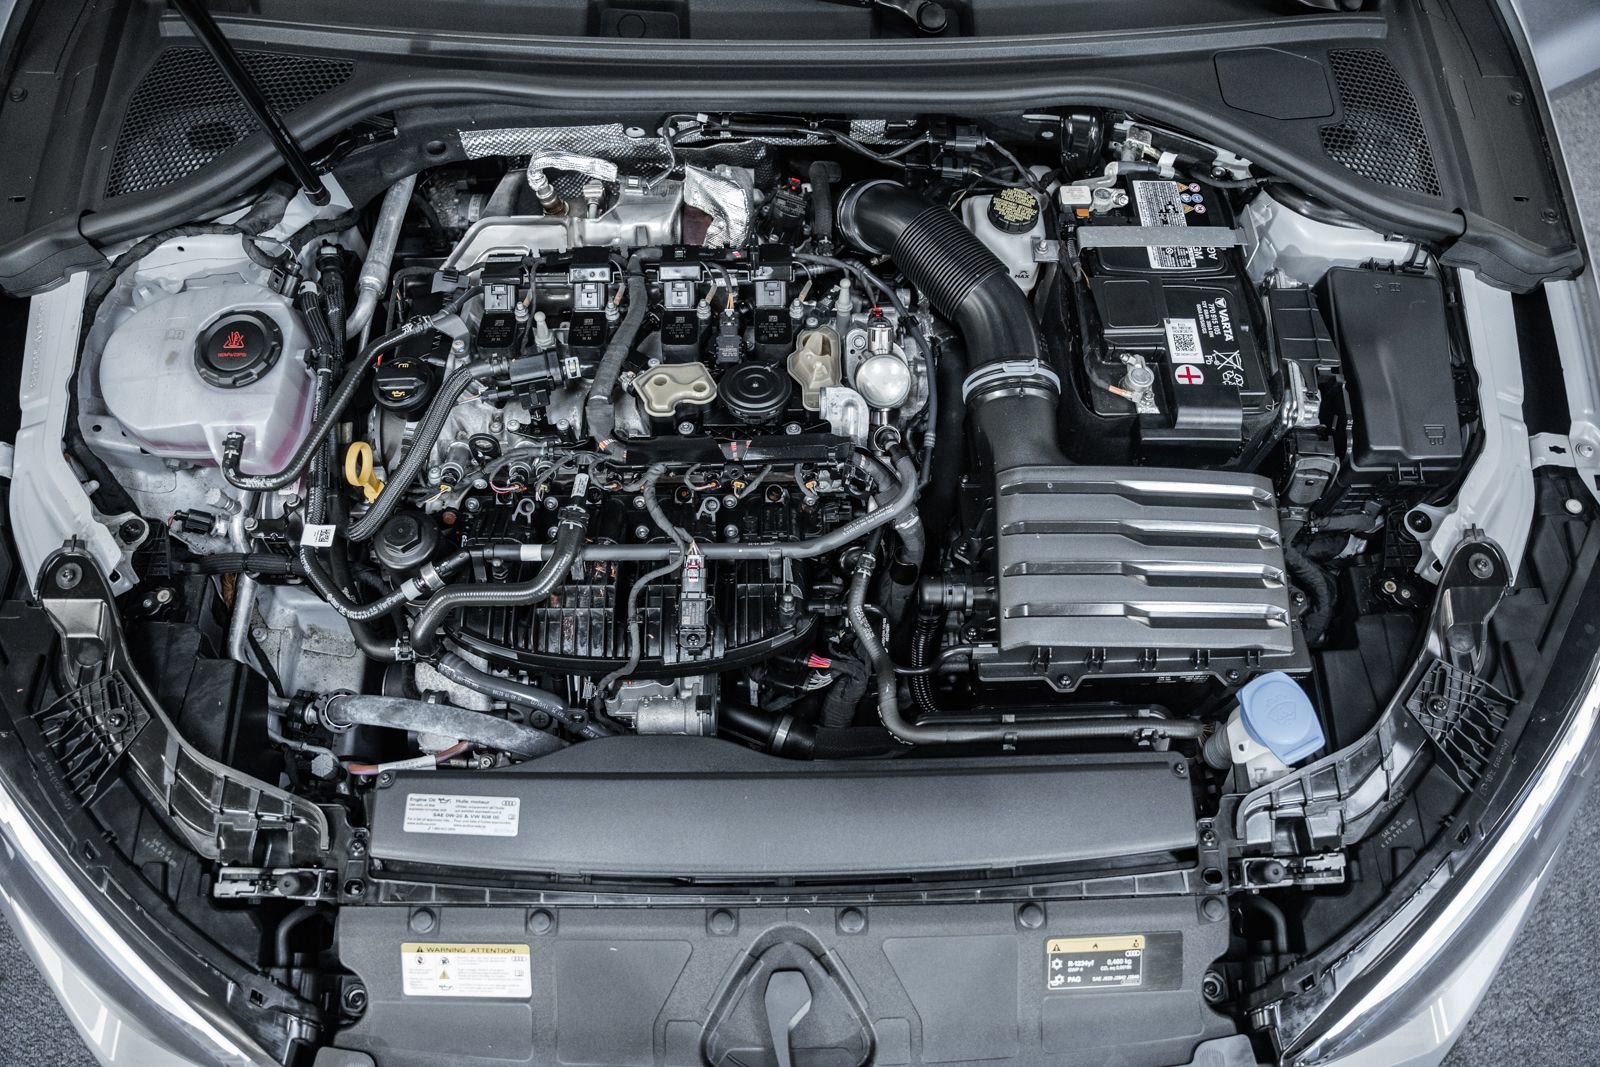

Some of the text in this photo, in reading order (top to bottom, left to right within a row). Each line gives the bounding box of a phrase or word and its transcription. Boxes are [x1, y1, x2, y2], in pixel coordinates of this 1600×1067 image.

[1207, 247, 1218, 260] AG
[1219, 309, 1234, 341] VARTA
[1204, 355, 1212, 365] Pb
